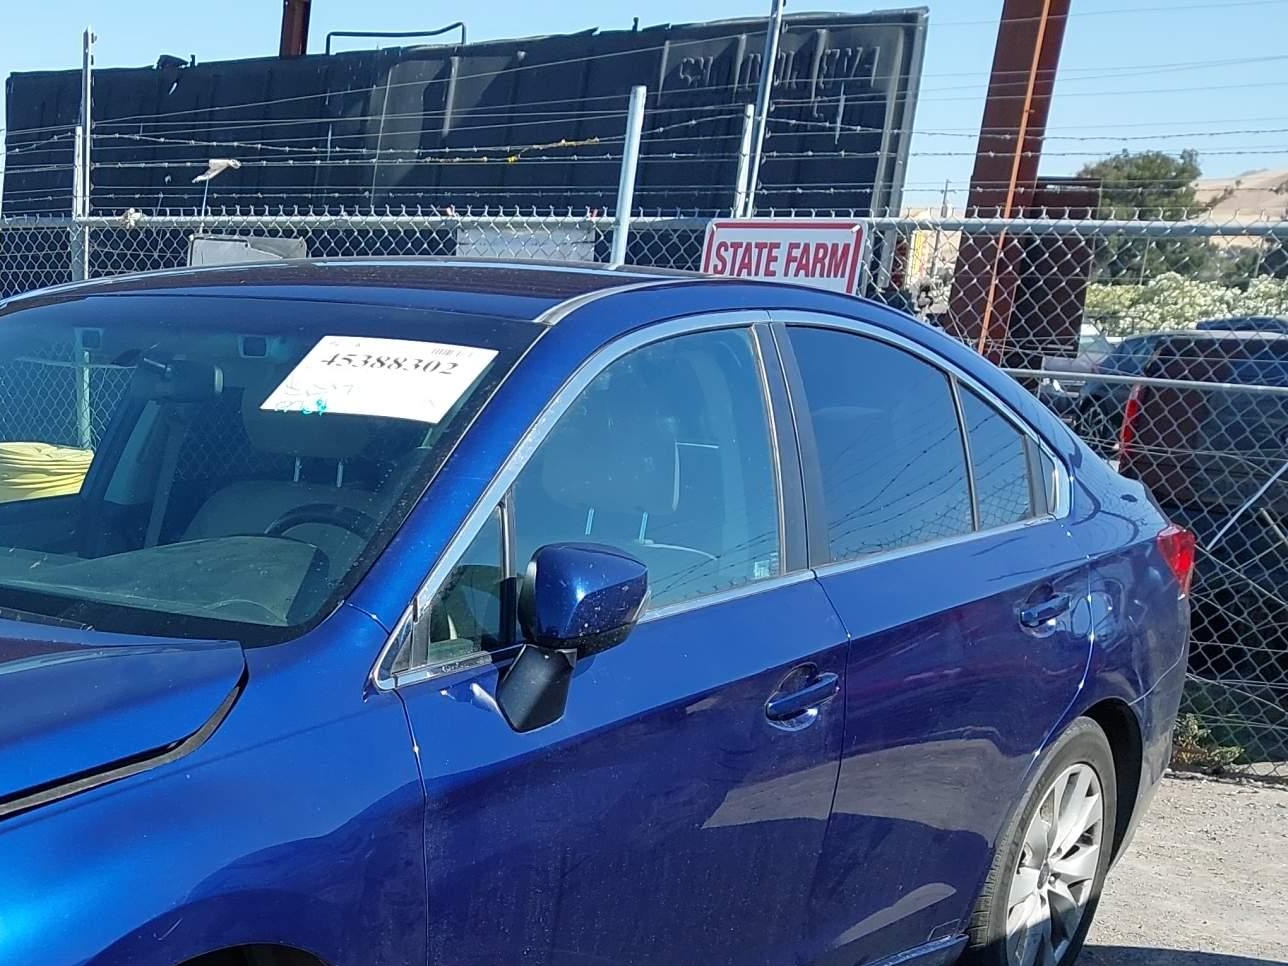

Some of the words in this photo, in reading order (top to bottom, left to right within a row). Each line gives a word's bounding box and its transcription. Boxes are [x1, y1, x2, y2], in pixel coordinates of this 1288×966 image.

[713, 241, 781, 277] STATE
[784, 242, 851, 279] FARM
[321, 352, 459, 375] 45388302
